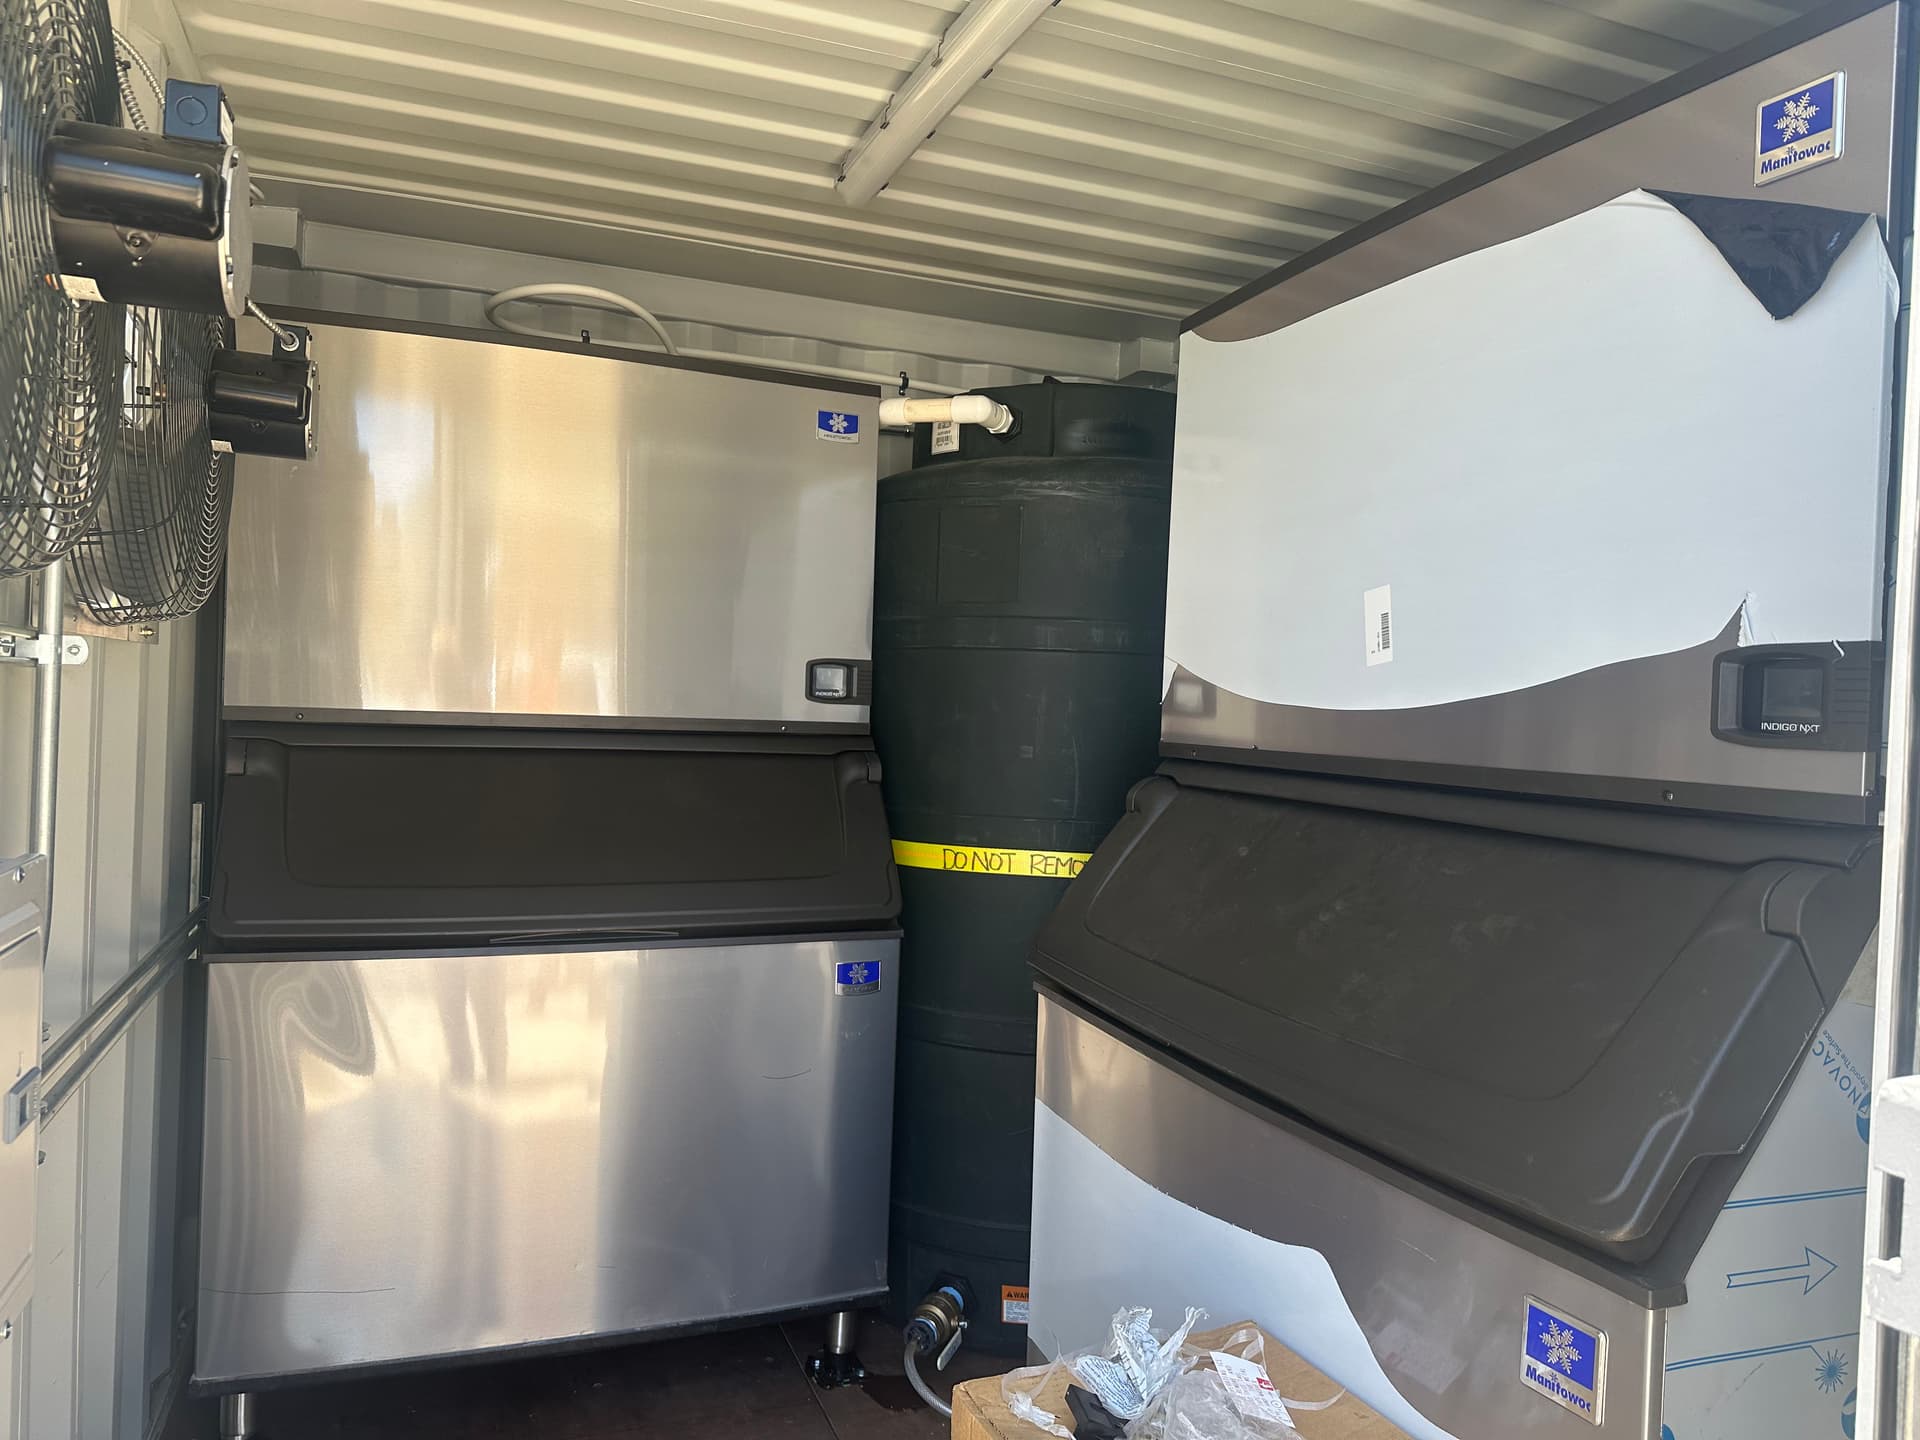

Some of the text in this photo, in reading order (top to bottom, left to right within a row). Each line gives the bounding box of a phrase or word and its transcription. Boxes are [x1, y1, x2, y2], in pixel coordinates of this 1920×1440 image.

[1760, 141, 1831, 175] Manitowoc
[1761, 722, 1820, 734] INDIGO NXT
[943, 848, 967, 870] DO
[971, 851, 1016, 873] NOT
[1822, 1029, 1869, 1090] Beyond The Surface
[1525, 1364, 1591, 1413] Manitowoc
